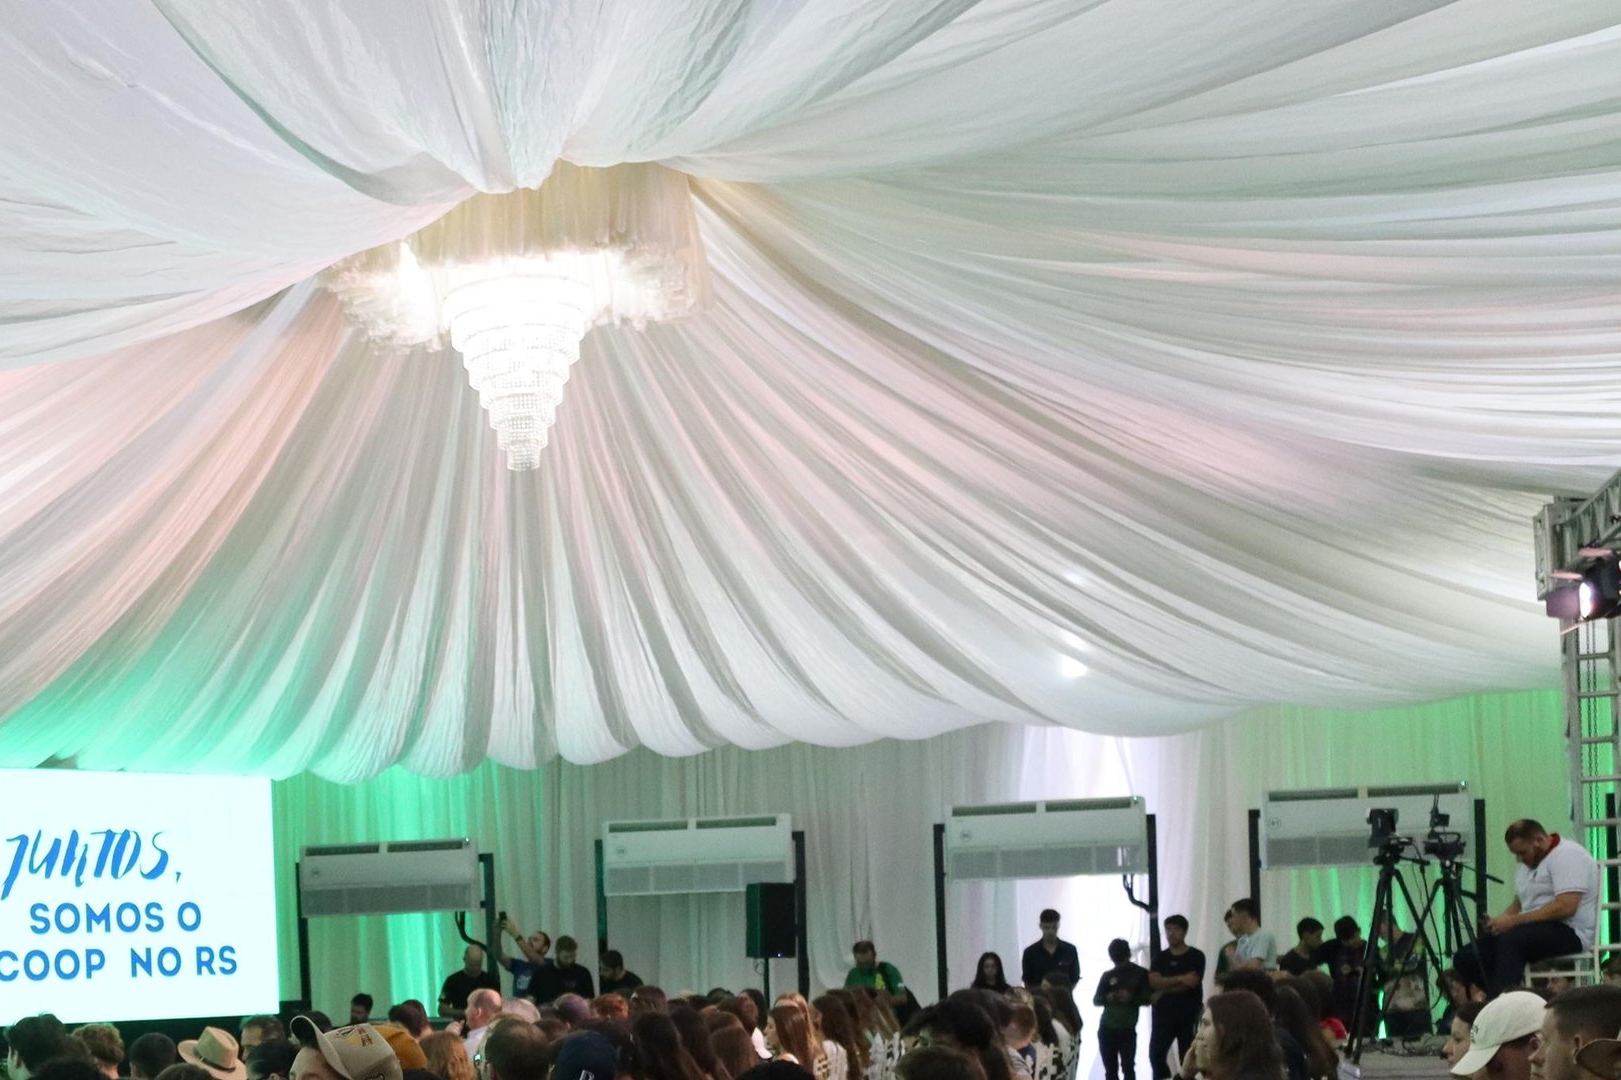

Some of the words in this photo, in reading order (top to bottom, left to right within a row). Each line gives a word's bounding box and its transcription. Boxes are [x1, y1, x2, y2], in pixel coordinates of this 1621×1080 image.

[30, 901, 164, 934] SOMOS
[177, 901, 202, 932] O
[130, 946, 182, 978] NO
[196, 945, 237, 976] RS
